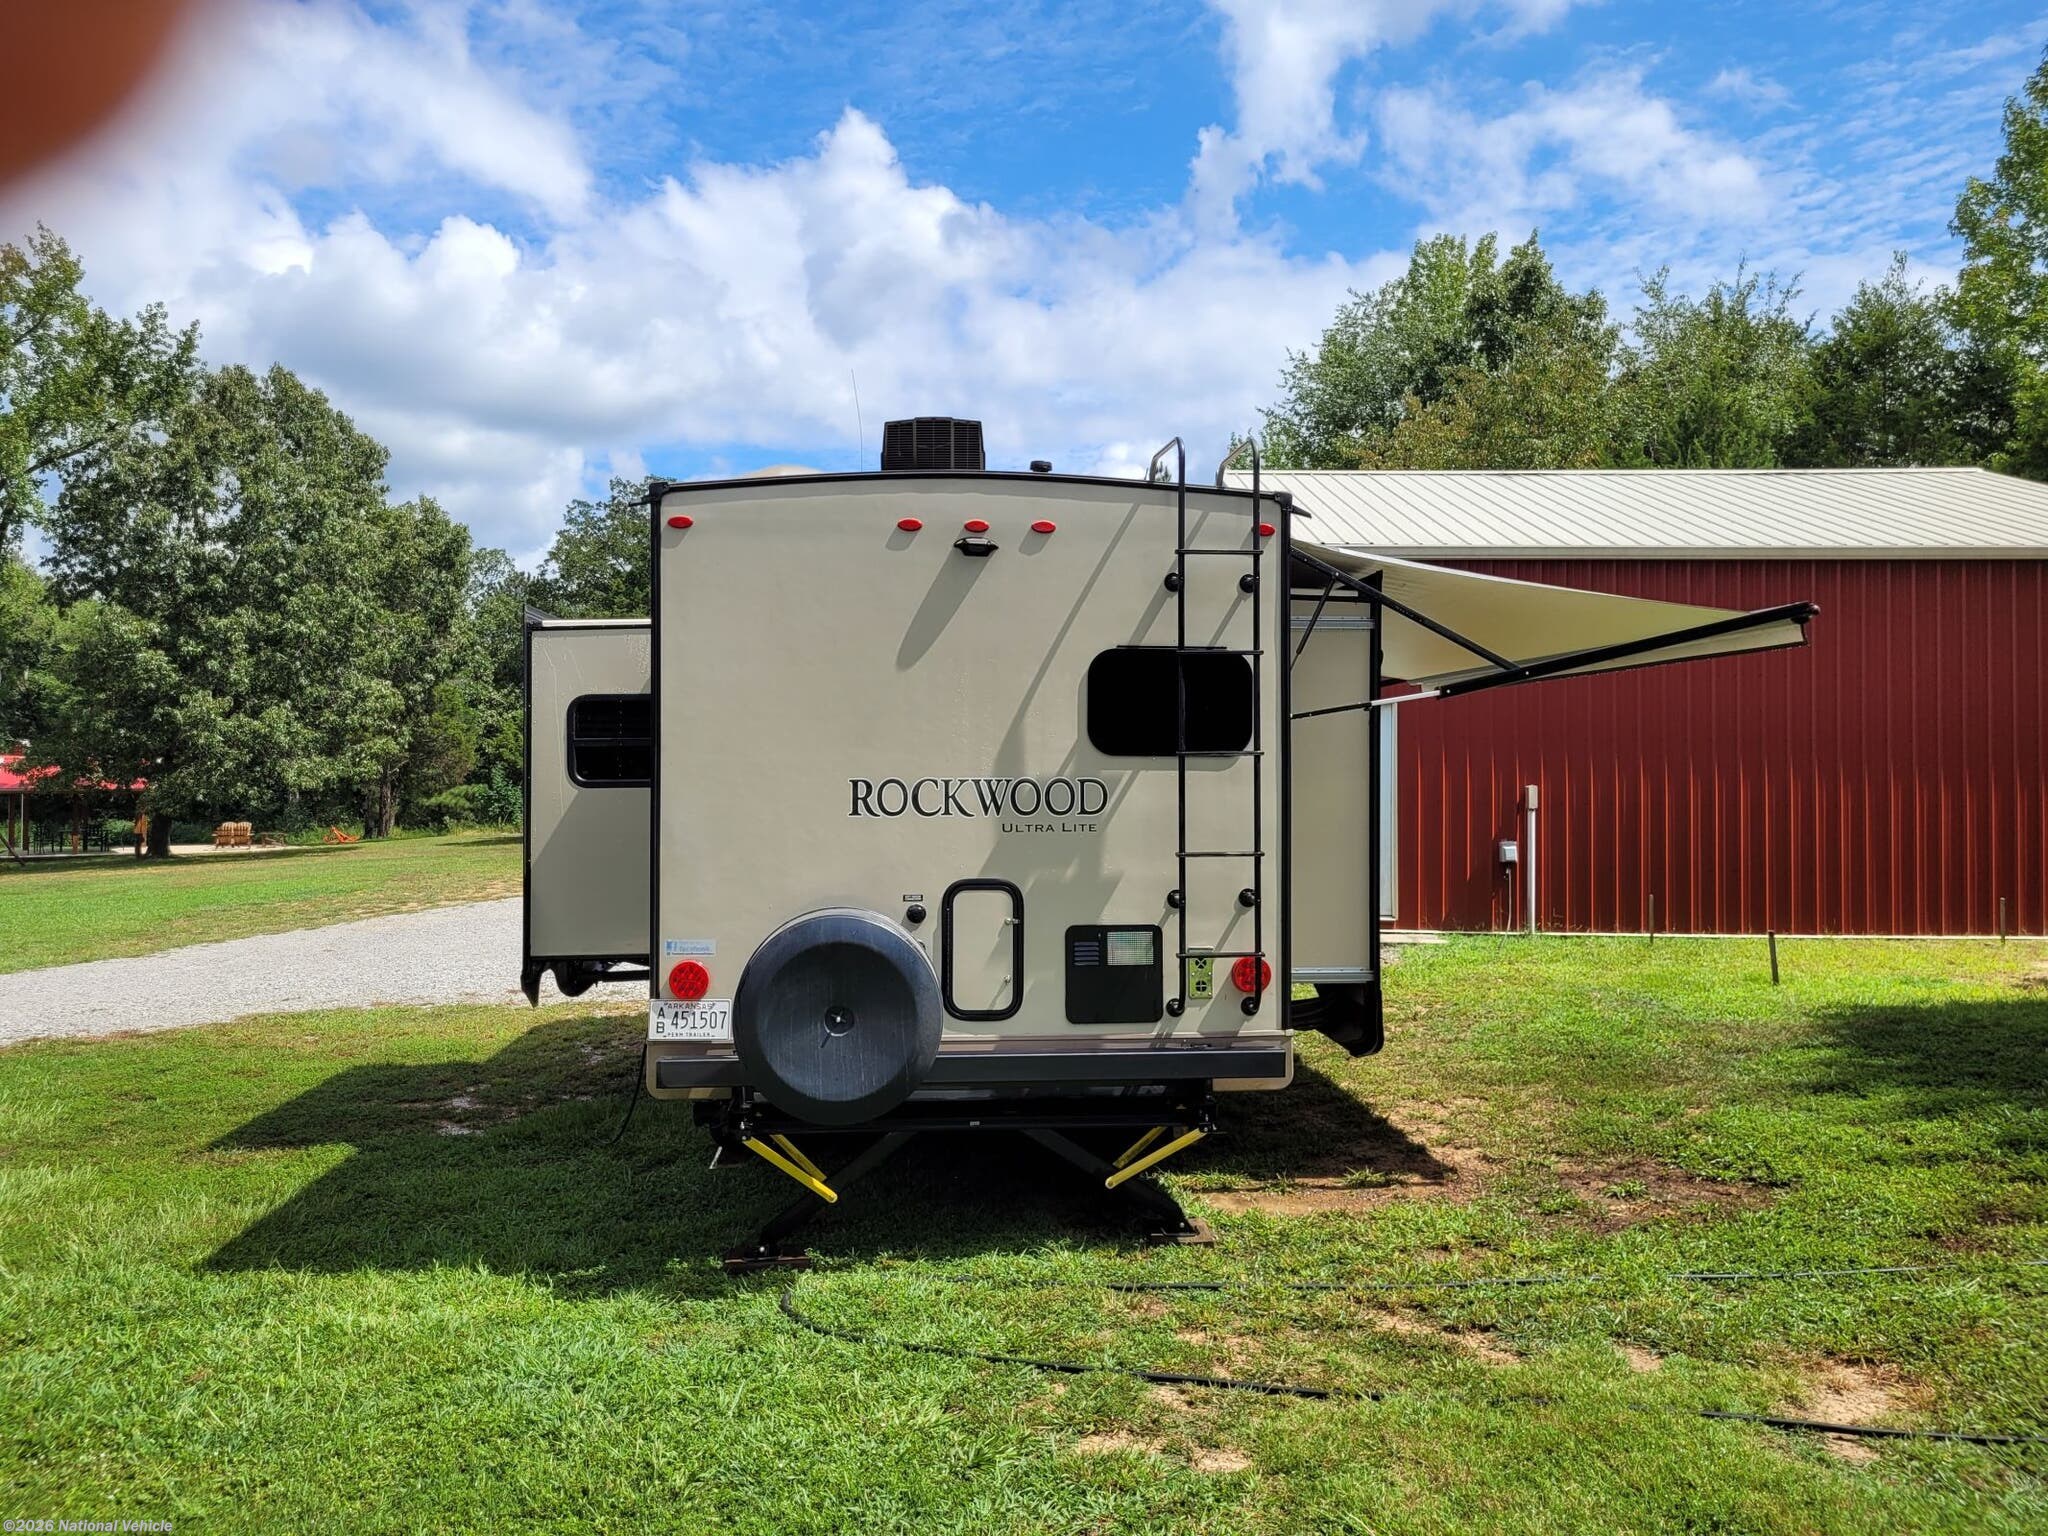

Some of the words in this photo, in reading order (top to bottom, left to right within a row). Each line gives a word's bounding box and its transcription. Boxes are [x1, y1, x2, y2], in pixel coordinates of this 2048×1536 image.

[848, 778, 1108, 817] ROCKWOOD
[1001, 823, 1055, 833] ULTRA
[1061, 822, 1097, 833] LITE
[667, 1002, 713, 1010] ARKANSAS
[671, 1010, 727, 1030] 451507
